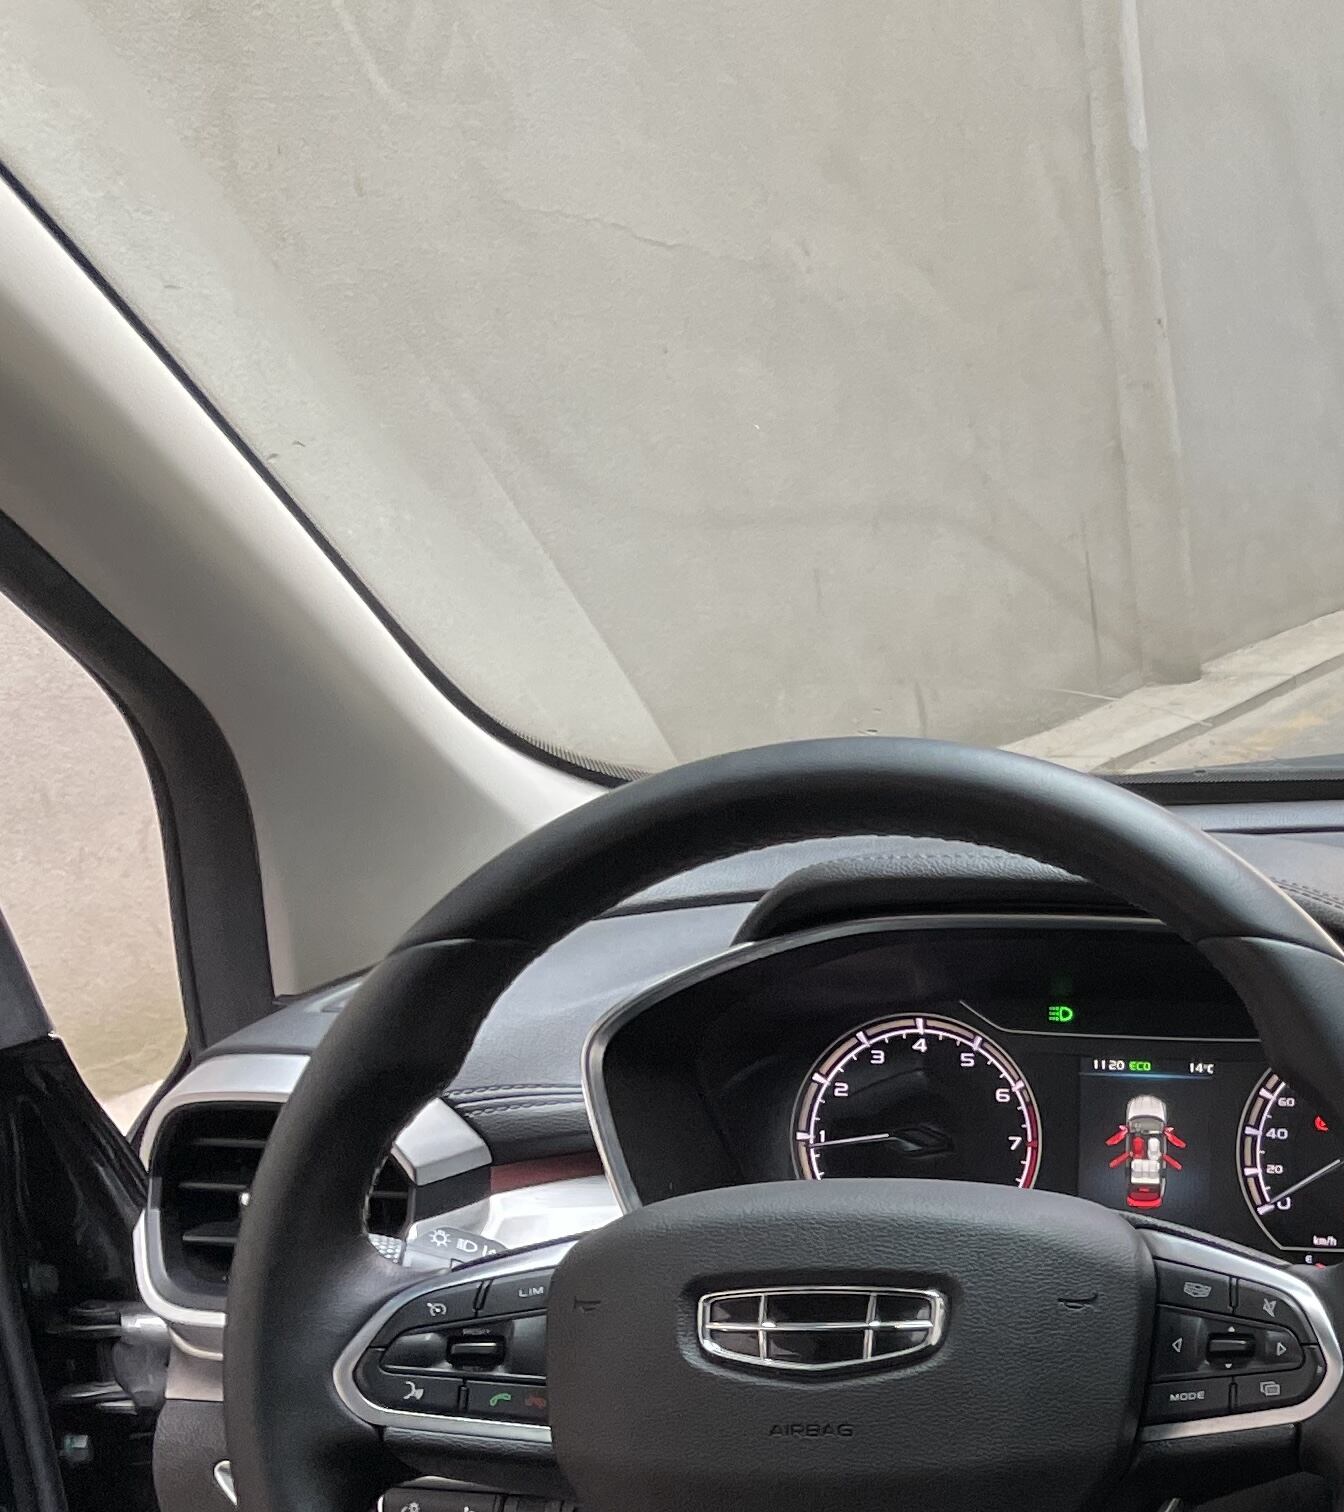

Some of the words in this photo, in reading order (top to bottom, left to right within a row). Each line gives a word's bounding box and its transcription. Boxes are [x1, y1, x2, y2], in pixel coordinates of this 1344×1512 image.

[912, 1038, 927, 1052] 4
[870, 1050, 885, 1065] 3
[960, 1053, 975, 1067] 5
[1128, 1061, 1152, 1071] ECO
[833, 1082, 849, 1097] 2
[995, 1088, 1011, 1103] 6
[1277, 1097, 1295, 1107] 60
[1266, 1128, 1288, 1140] 40
[1008, 1136, 1022, 1150] 7
[1266, 1164, 1283, 1174] 20
[1313, 1235, 1337, 1247] km/h
[518, 1286, 545, 1298] LIM
[1170, 1390, 1205, 1401] MODE
[768, 1423, 855, 1438] AIRBAG
